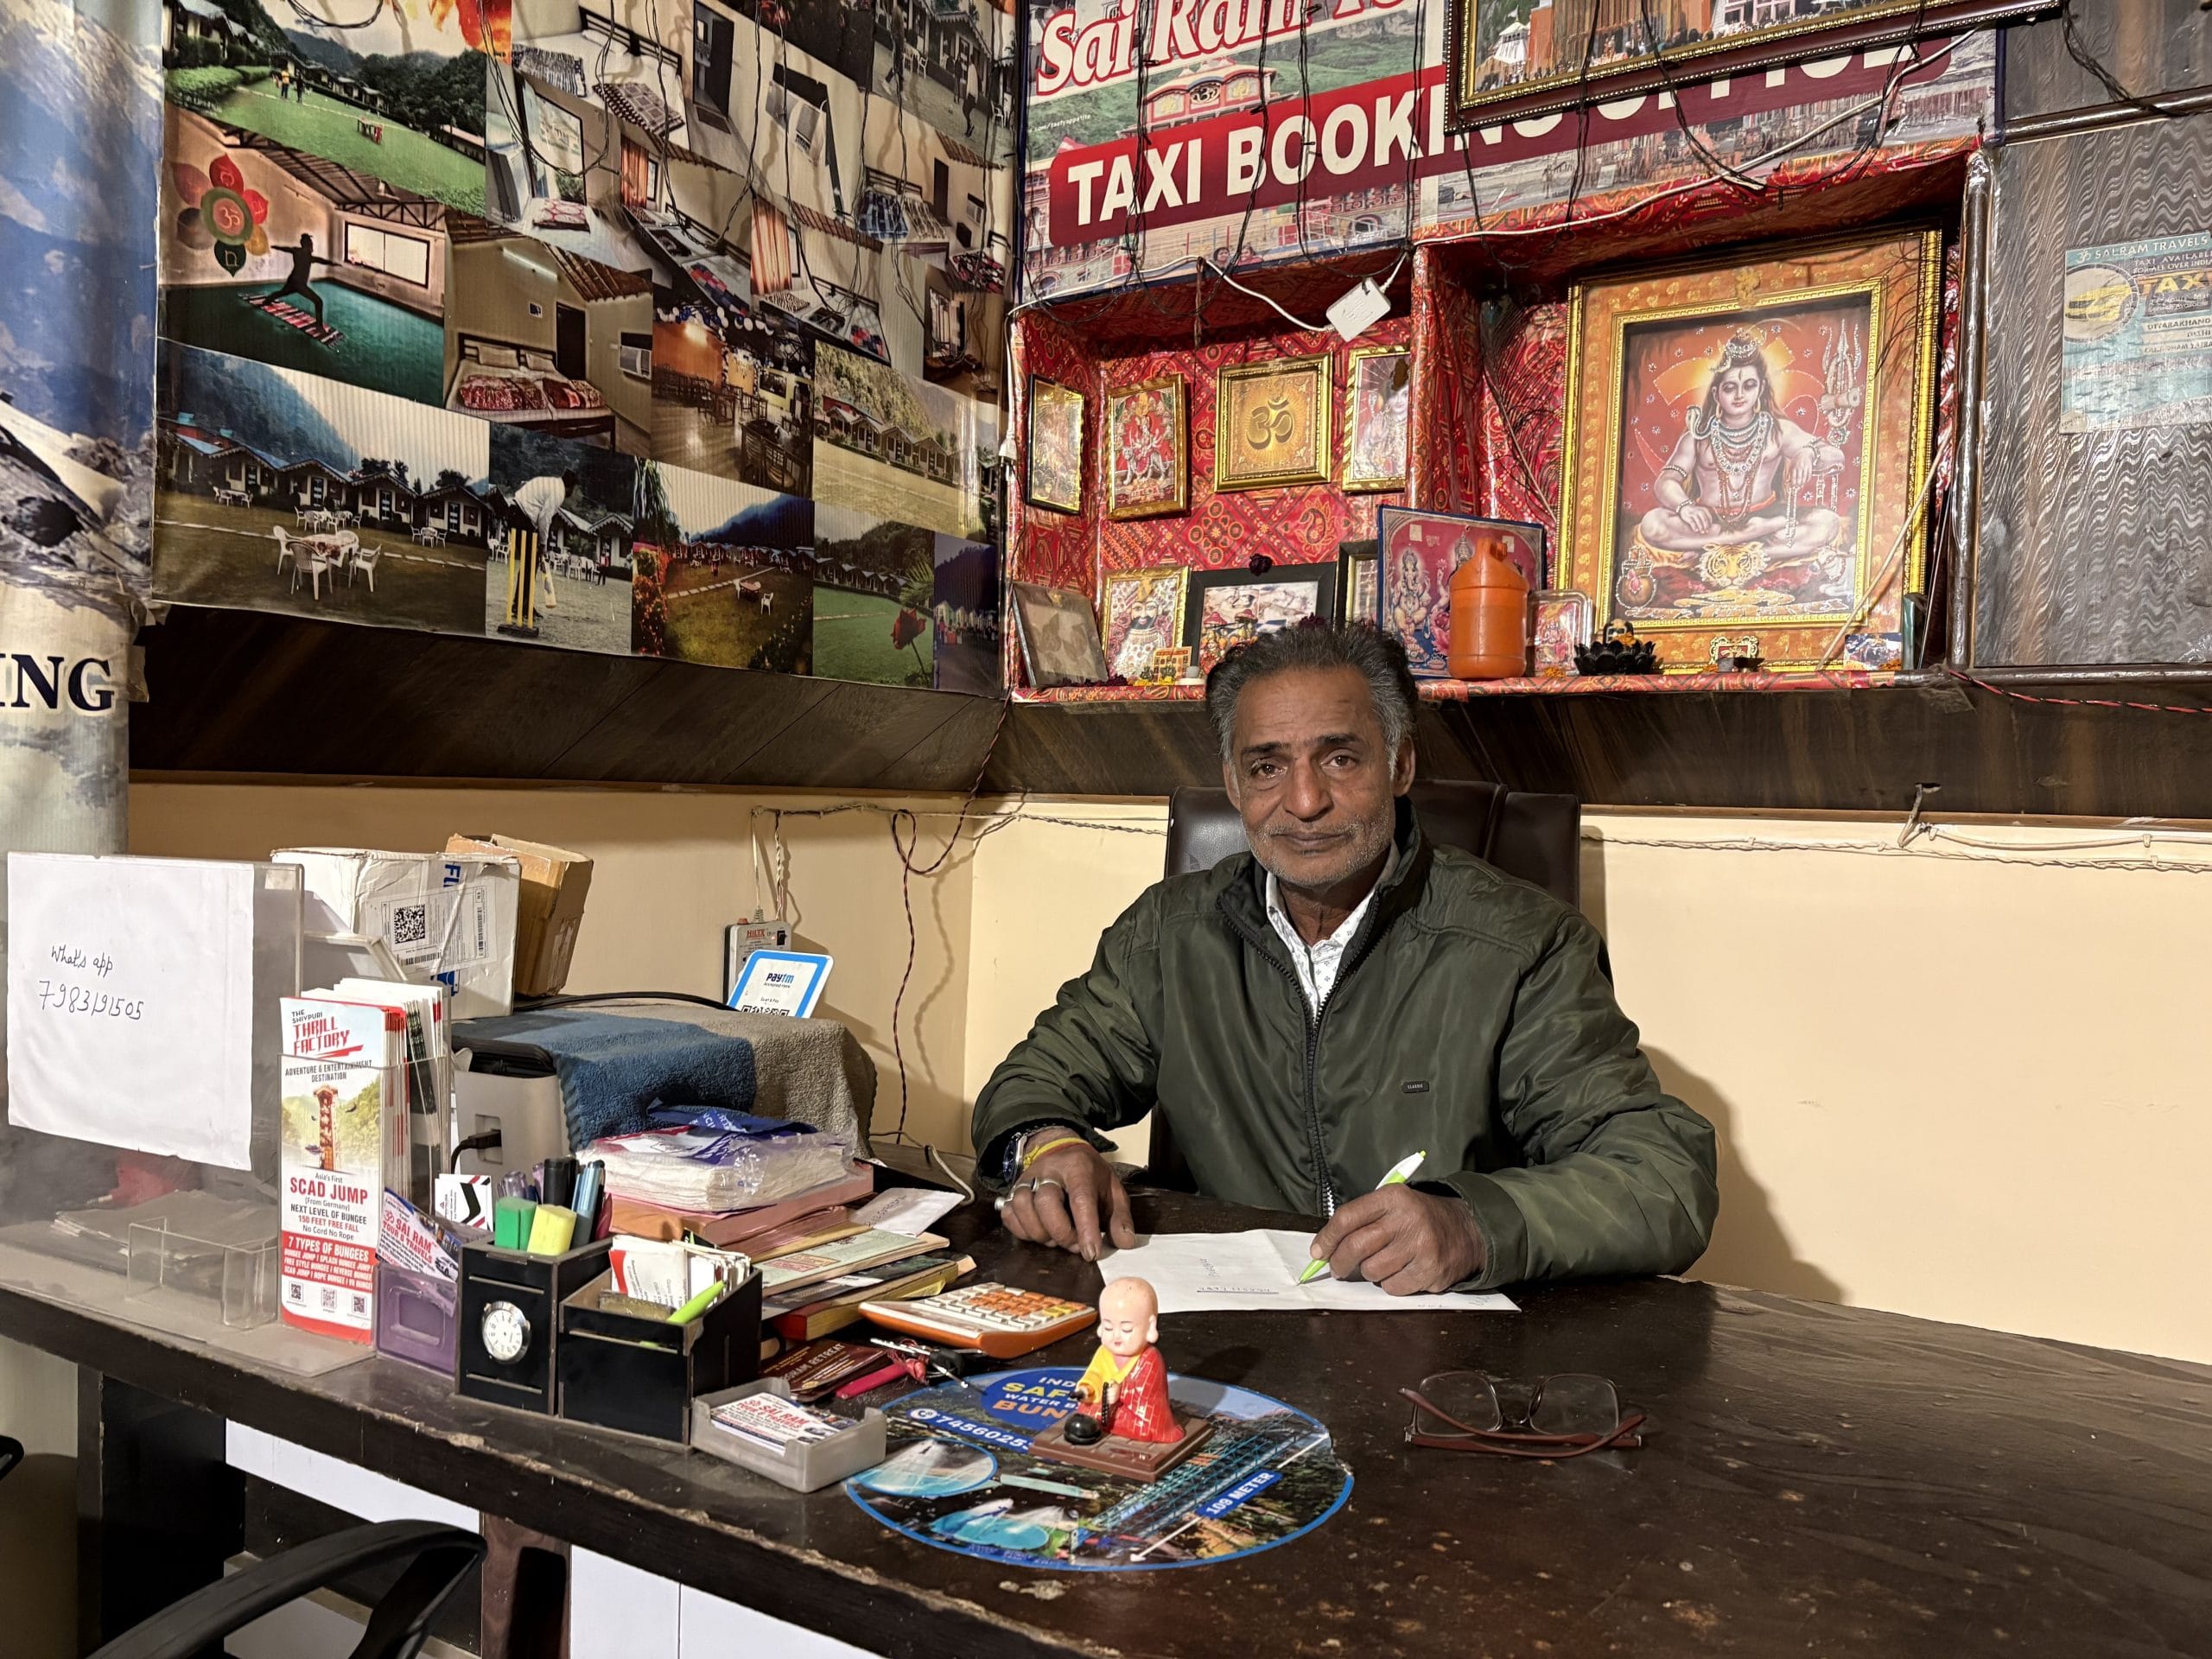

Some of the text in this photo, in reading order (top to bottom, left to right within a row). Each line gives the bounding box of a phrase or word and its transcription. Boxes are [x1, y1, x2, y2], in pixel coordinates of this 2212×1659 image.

[1037, 3, 1133, 95] Sai
[1068, 85, 1566, 226] TAXI BOOKI
[2153, 235, 2209, 251] TRAVELS
[2167, 261, 2190, 270] OVER
[2147, 317, 2211, 330] UTTARAKHAND
[0, 653, 115, 711] NG
[92, 952, 113, 978] app
[291, 1009, 305, 1018] THE
[293, 1016, 338, 1041] THRILL
[293, 1029, 350, 1056] FACTORY
[285, 1065, 316, 1077] ADVENTURE
[324, 1060, 372, 1072] ENTERTAINMENT
[311, 1071, 347, 1083] DESTINATION
[315, 1173, 343, 1184] Asia's First
[289, 1177, 326, 1198] SCAD
[330, 1184, 368, 1205] JUMP
[305, 1196, 350, 1211] (From Germany)
[290, 1204, 367, 1224] NEXT LEVEL OF BUNGEE
[298, 1215, 359, 1233] 150 FEET FREE FALL
[302, 1224, 354, 1242] No Cord No Rope
[383, 1220, 398, 1237] TOUR
[406, 1238, 432, 1264] TRAVELS
[397, 1218, 410, 1236] SAI
[413, 1230, 432, 1253] RAM
[288, 1236, 295, 1248] 7
[296, 1236, 321, 1253] TYPES
[322, 1242, 334, 1255] OF
[334, 1243, 369, 1262] BUNGEES
[809, 1343, 846, 1366] RETREAT
[1002, 1382, 1078, 1402] SAF
[1038, 1376, 1077, 1388] IND
[992, 1399, 1068, 1420] BUN
[1005, 1393, 1062, 1407] WATER
[779, 1413, 810, 1425] RAM
[1205, 1471, 1276, 1516] 109 METER
